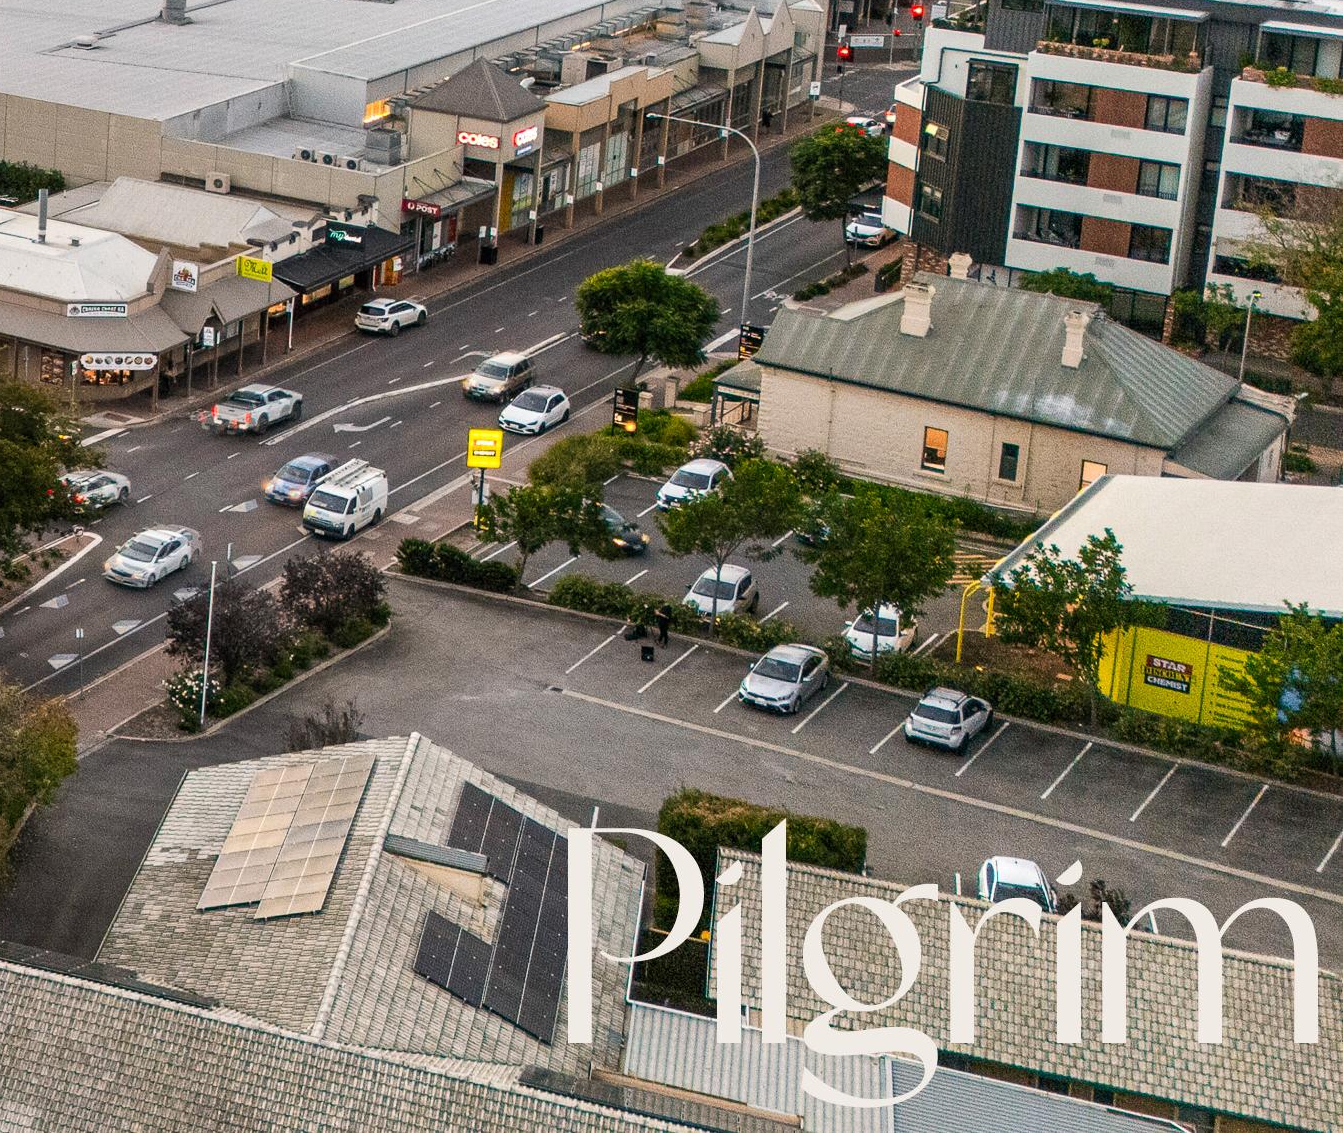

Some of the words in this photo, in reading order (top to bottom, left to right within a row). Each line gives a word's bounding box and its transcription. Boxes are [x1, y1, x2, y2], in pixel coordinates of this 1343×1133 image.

[458, 132, 499, 149] coles
[416, 204, 438, 214] POST
[1153, 658, 1186, 673] STAR
[1147, 675, 1188, 692] CHEMIST
